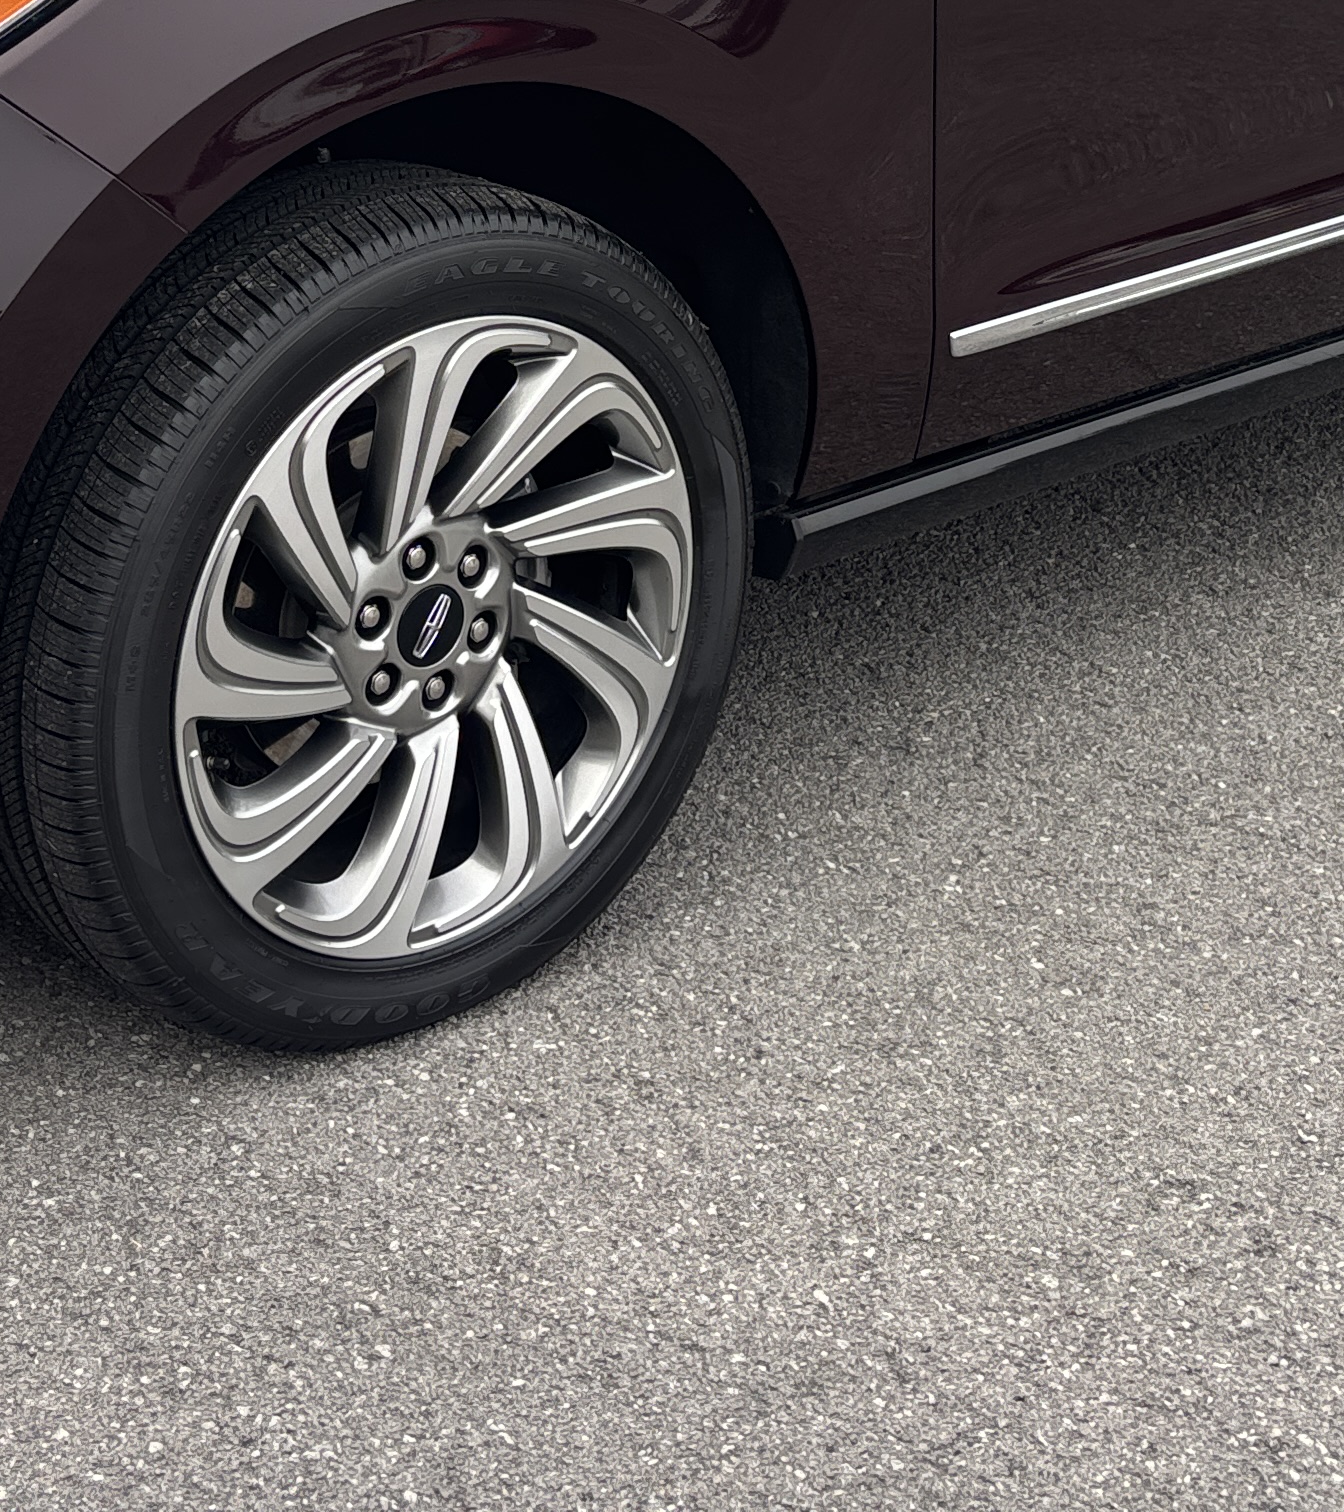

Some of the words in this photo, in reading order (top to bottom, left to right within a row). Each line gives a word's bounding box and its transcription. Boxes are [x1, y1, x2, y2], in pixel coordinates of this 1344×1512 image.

[402, 256, 568, 297] EAGLE
[580, 270, 714, 413] TOURING
[174, 919, 492, 1029] GOODYEAR
